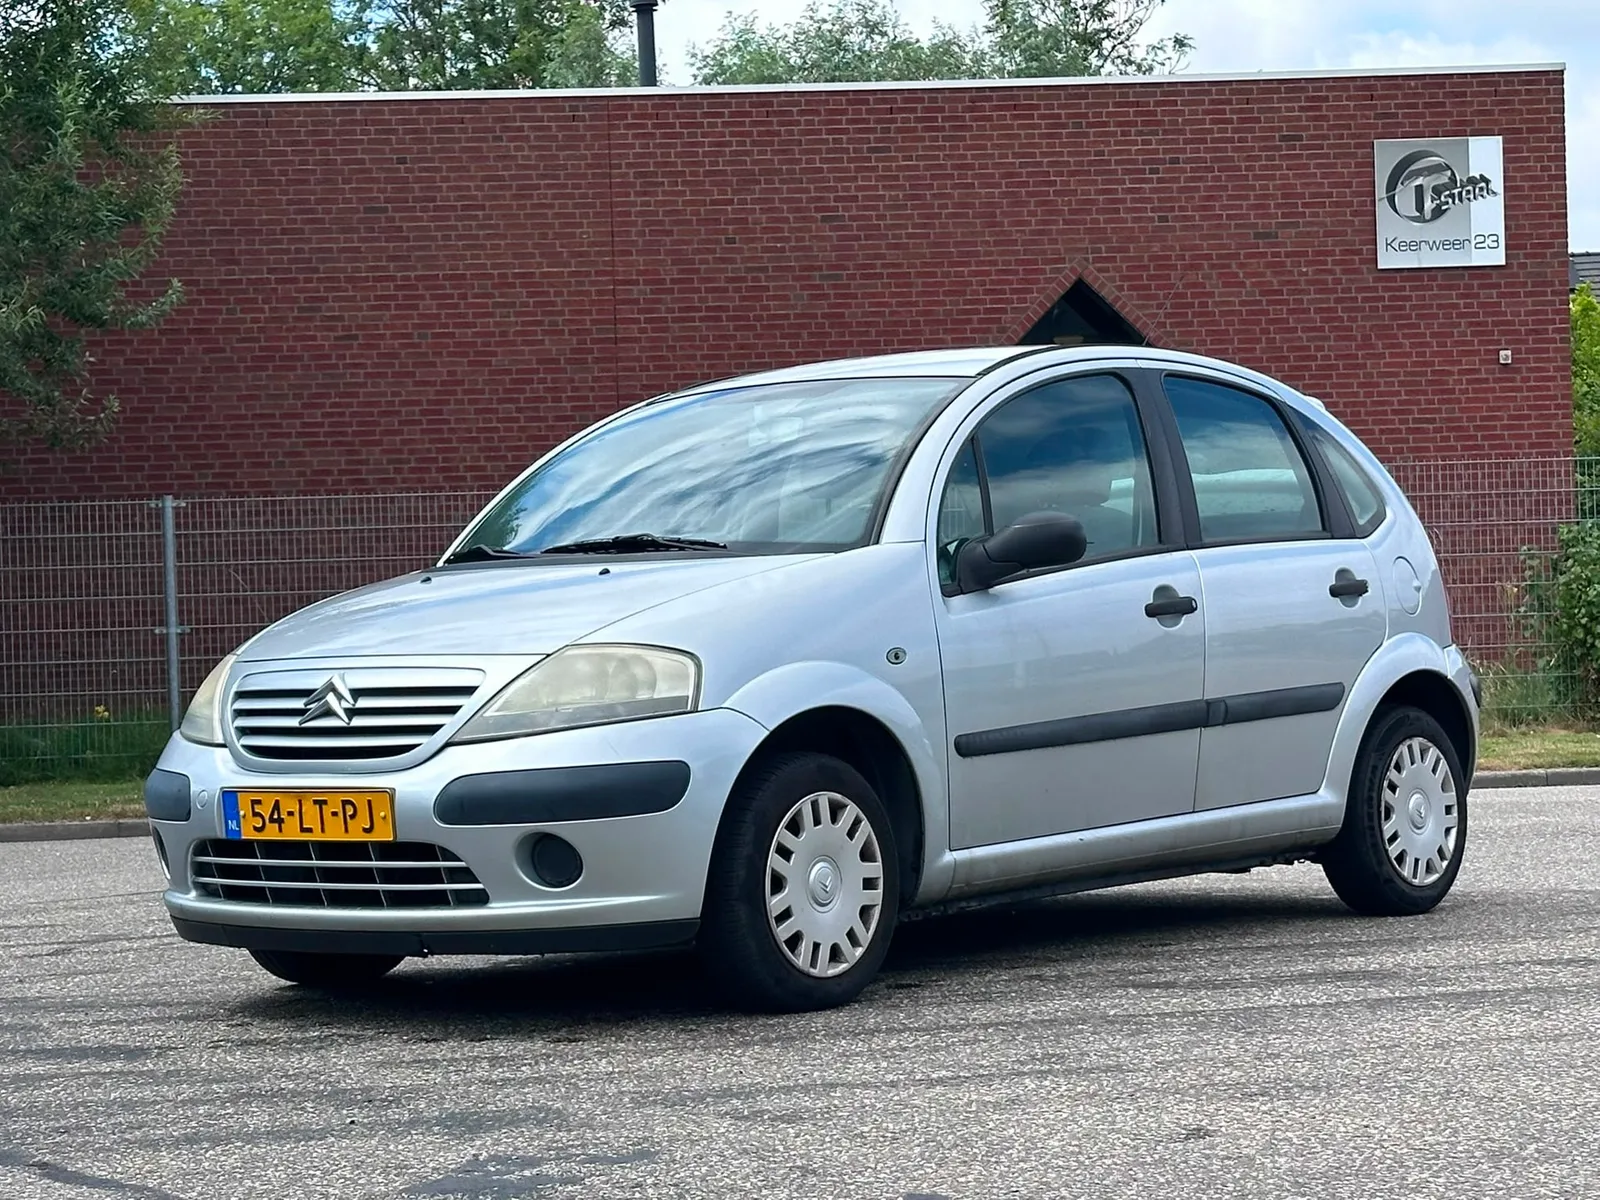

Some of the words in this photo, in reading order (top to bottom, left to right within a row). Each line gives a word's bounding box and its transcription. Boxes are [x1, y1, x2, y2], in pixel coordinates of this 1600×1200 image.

[1385, 237, 1471, 252] Keerweer
[1474, 234, 1500, 249] 23
[250, 798, 375, 833] 54-LT-PJ
[228, 819, 240, 831] NL
